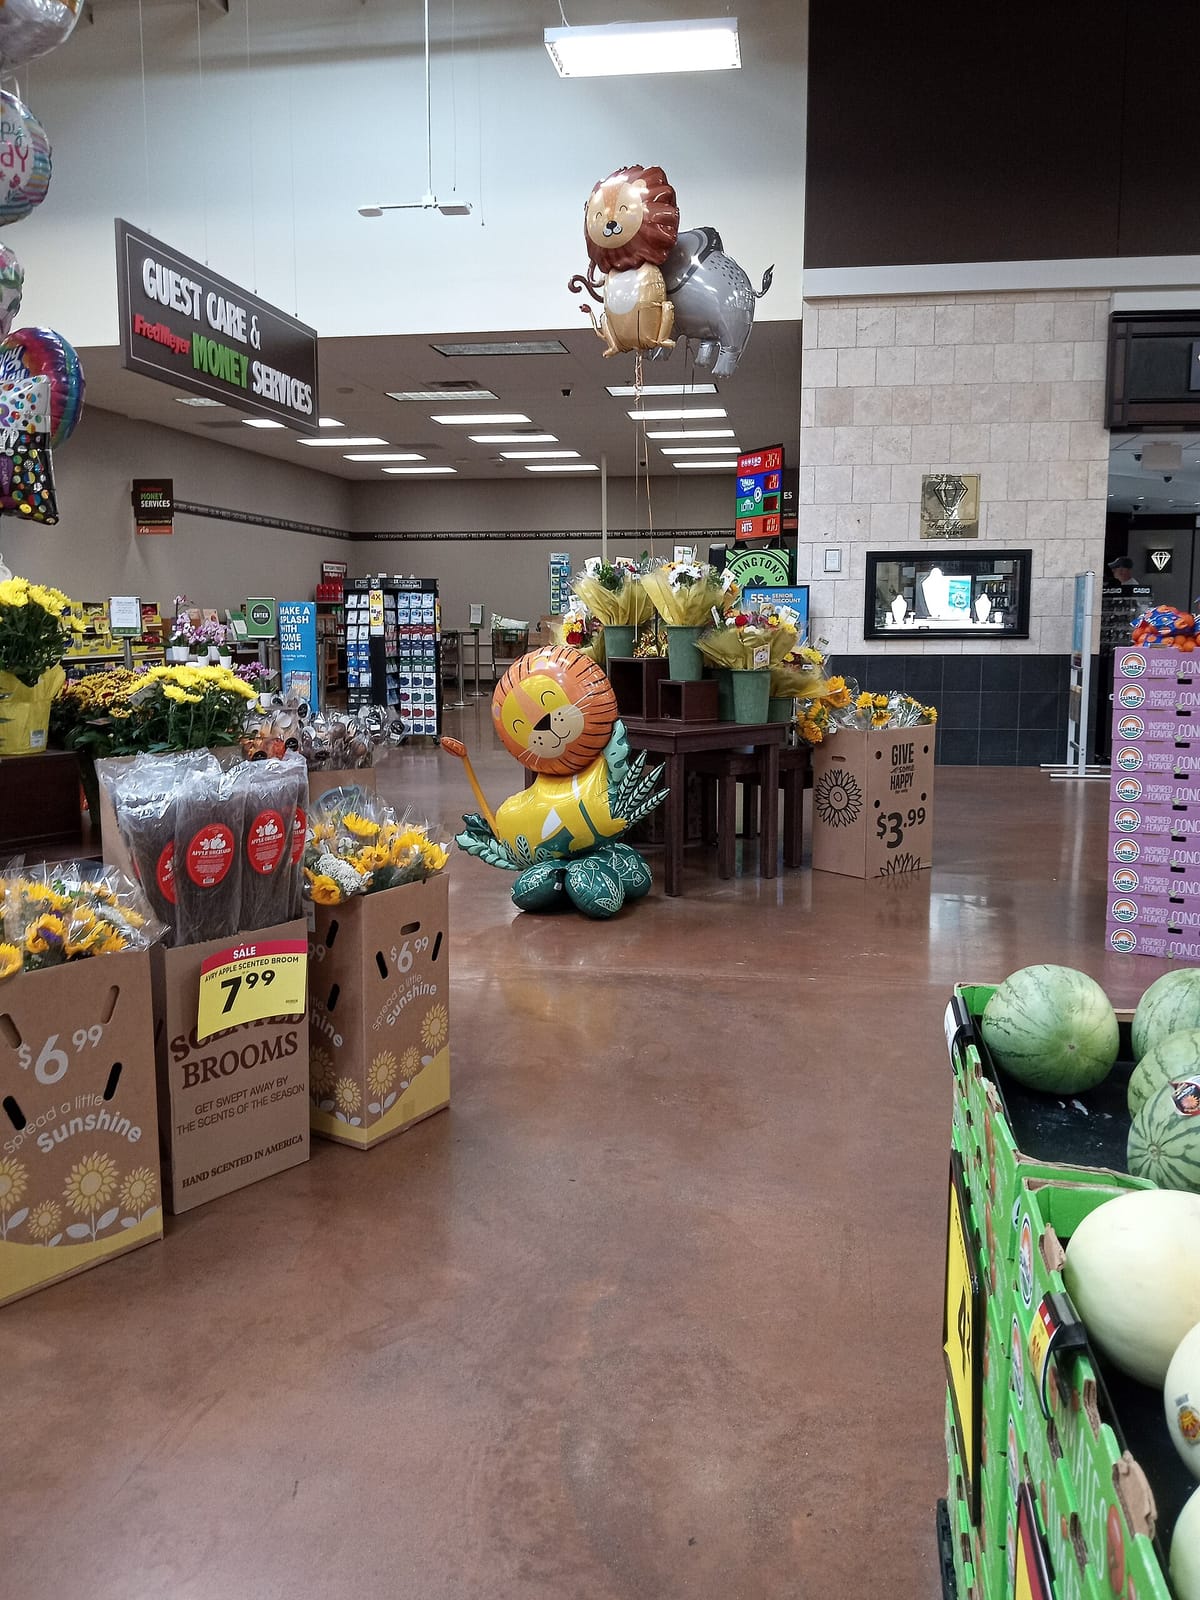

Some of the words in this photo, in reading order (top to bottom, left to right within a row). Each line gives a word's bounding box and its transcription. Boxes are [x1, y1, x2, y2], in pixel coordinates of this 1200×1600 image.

[142, 258, 202, 320] GUEST
[206, 292, 248, 344] CARE
[250, 315, 262, 350] &
[192, 332, 249, 388] MONEY
[252, 360, 312, 416] SERVICES
[140, 492, 163, 500] MONEY
[140, 500, 171, 508] SERVICES
[750, 594, 772, 603] 55+
[280, 606, 300, 615] MAKE
[303, 606, 310, 615] A
[280, 616, 309, 624] SPLASH
[280, 624, 298, 633] WITH
[280, 634, 302, 642] SOME
[281, 642, 302, 650] CASH
[1150, 659, 1178, 667] INSPIRED
[1150, 690, 1176, 698] INSPIRED
[1148, 722, 1176, 730] INSPIRED
[892, 742, 914, 766] GIVE
[1147, 754, 1174, 762] INSPIRED
[890, 772, 914, 790] HAPPY
[1146, 784, 1173, 793] INSPIRED
[1145, 816, 1172, 824] INSPIRED
[876, 807, 926, 848] $3.99
[1144, 846, 1170, 856] INSPIRED
[1142, 876, 1170, 886] INSPIRED
[1142, 906, 1168, 916] INSPIRED
[1141, 937, 1167, 946] INSPIRED
[233, 946, 256, 960] SALE
[218, 965, 237, 976] APPLE
[238, 958, 270, 970] SCENTED
[271, 956, 299, 964] BROOM
[182, 1032, 298, 1089] BROOMS
[194, 1100, 213, 1115] GET
[216, 1089, 248, 1108] SWEPT
[250, 1080, 276, 1096] AWAY
[276, 1075, 288, 1087] BY
[60, 1102, 71, 1114] a
[75, 1093, 104, 1110] little
[176, 1120, 197, 1136] THE
[198, 1108, 235, 1128] SCENTS
[237, 1103, 250, 1114] OF
[251, 1095, 269, 1110] THE
[270, 1084, 305, 1102] SEASON
[182, 1171, 210, 1188] HAND
[211, 1154, 253, 1176] SCENTED
[254, 1150, 264, 1160] IN
[264, 1134, 304, 1157] AMERICA
